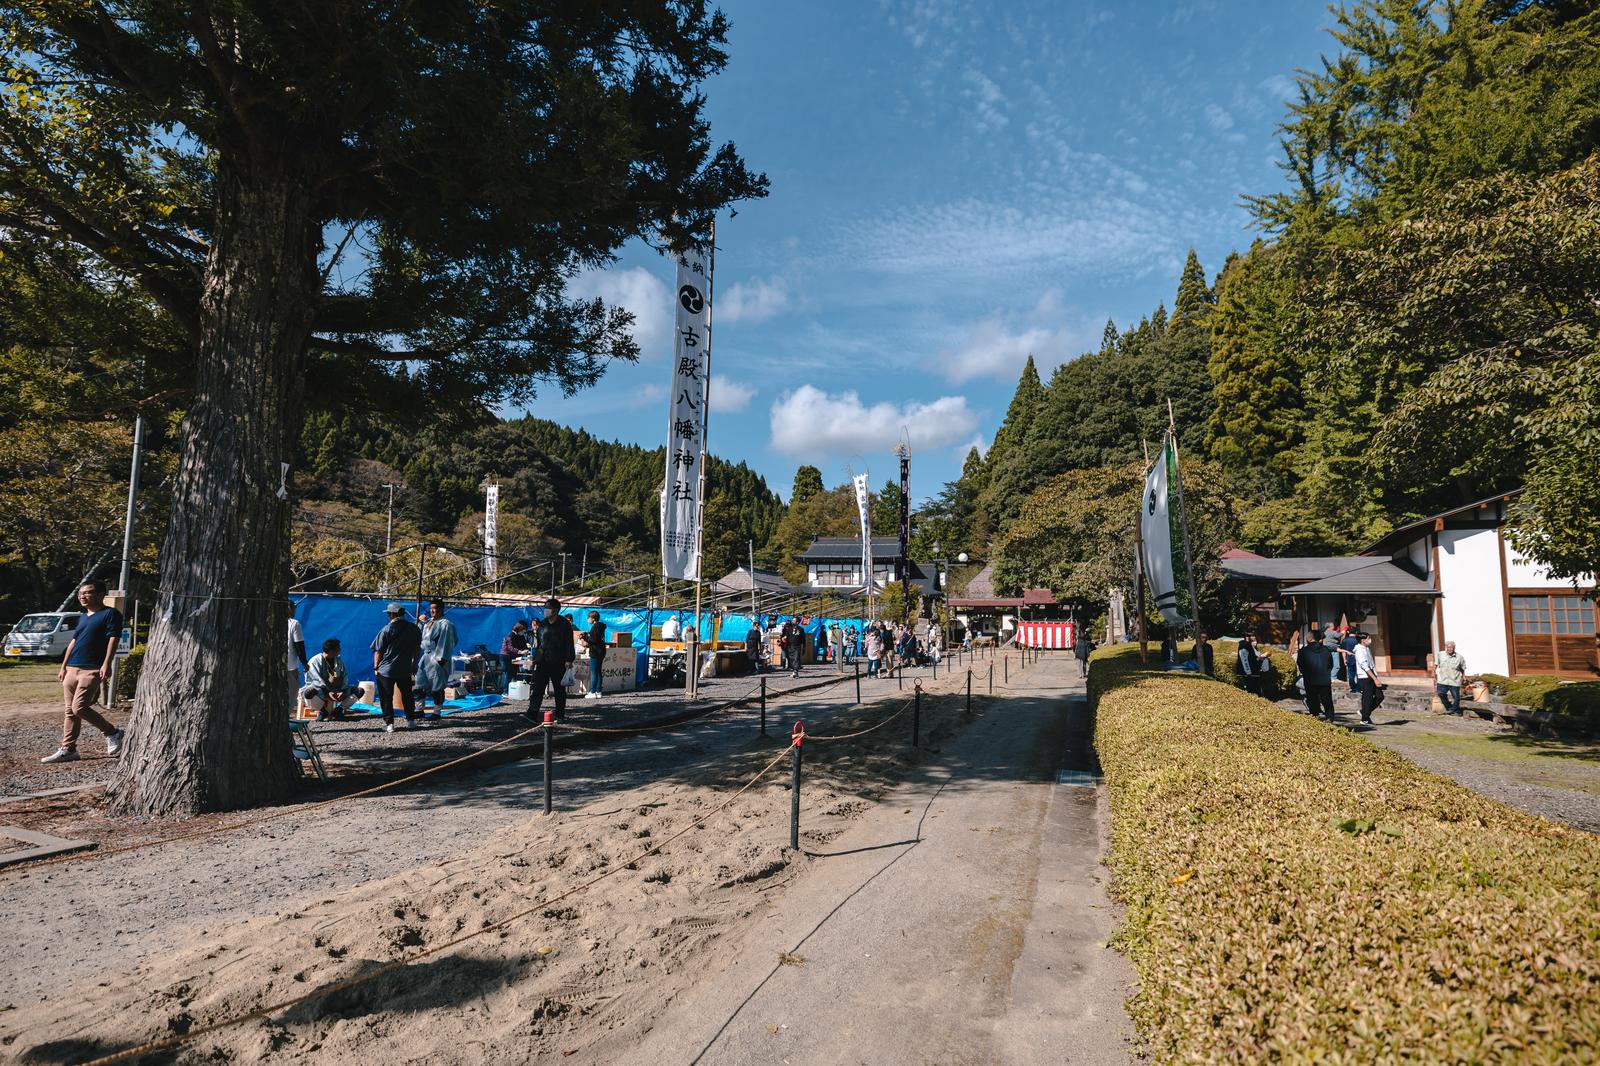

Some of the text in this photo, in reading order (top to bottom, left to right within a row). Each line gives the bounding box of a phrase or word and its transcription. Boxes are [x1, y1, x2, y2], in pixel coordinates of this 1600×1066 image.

[671, 326, 700, 501] 古殿八幡神社
